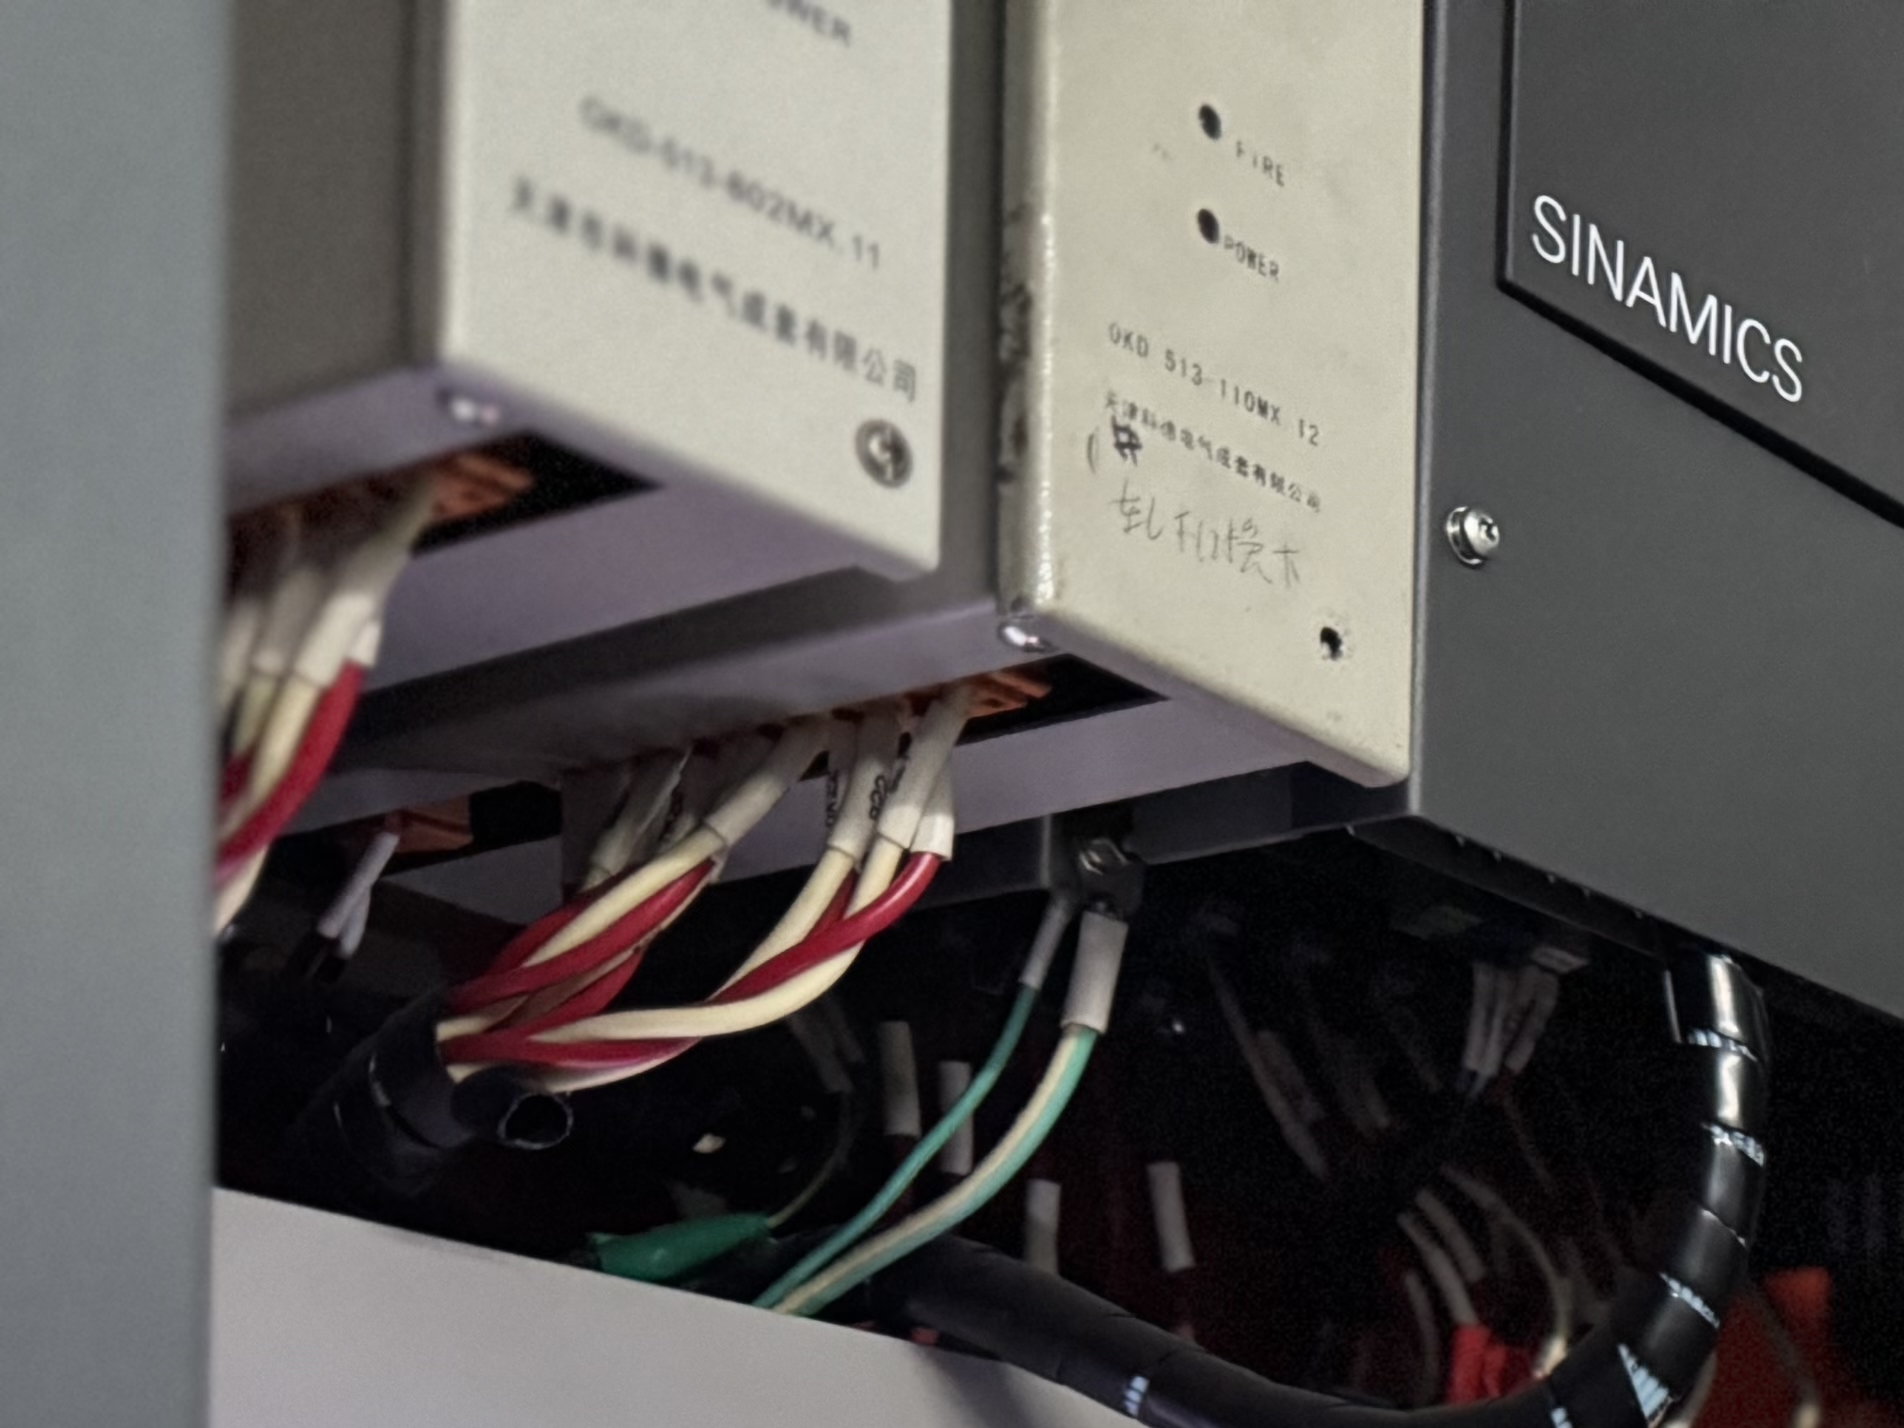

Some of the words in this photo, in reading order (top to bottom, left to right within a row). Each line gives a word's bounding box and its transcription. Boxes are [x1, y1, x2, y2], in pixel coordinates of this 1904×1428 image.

[1236, 139, 1287, 188] FIRE
[1223, 234, 1281, 283] POWER
[1531, 195, 1803, 402] SINAMICS
